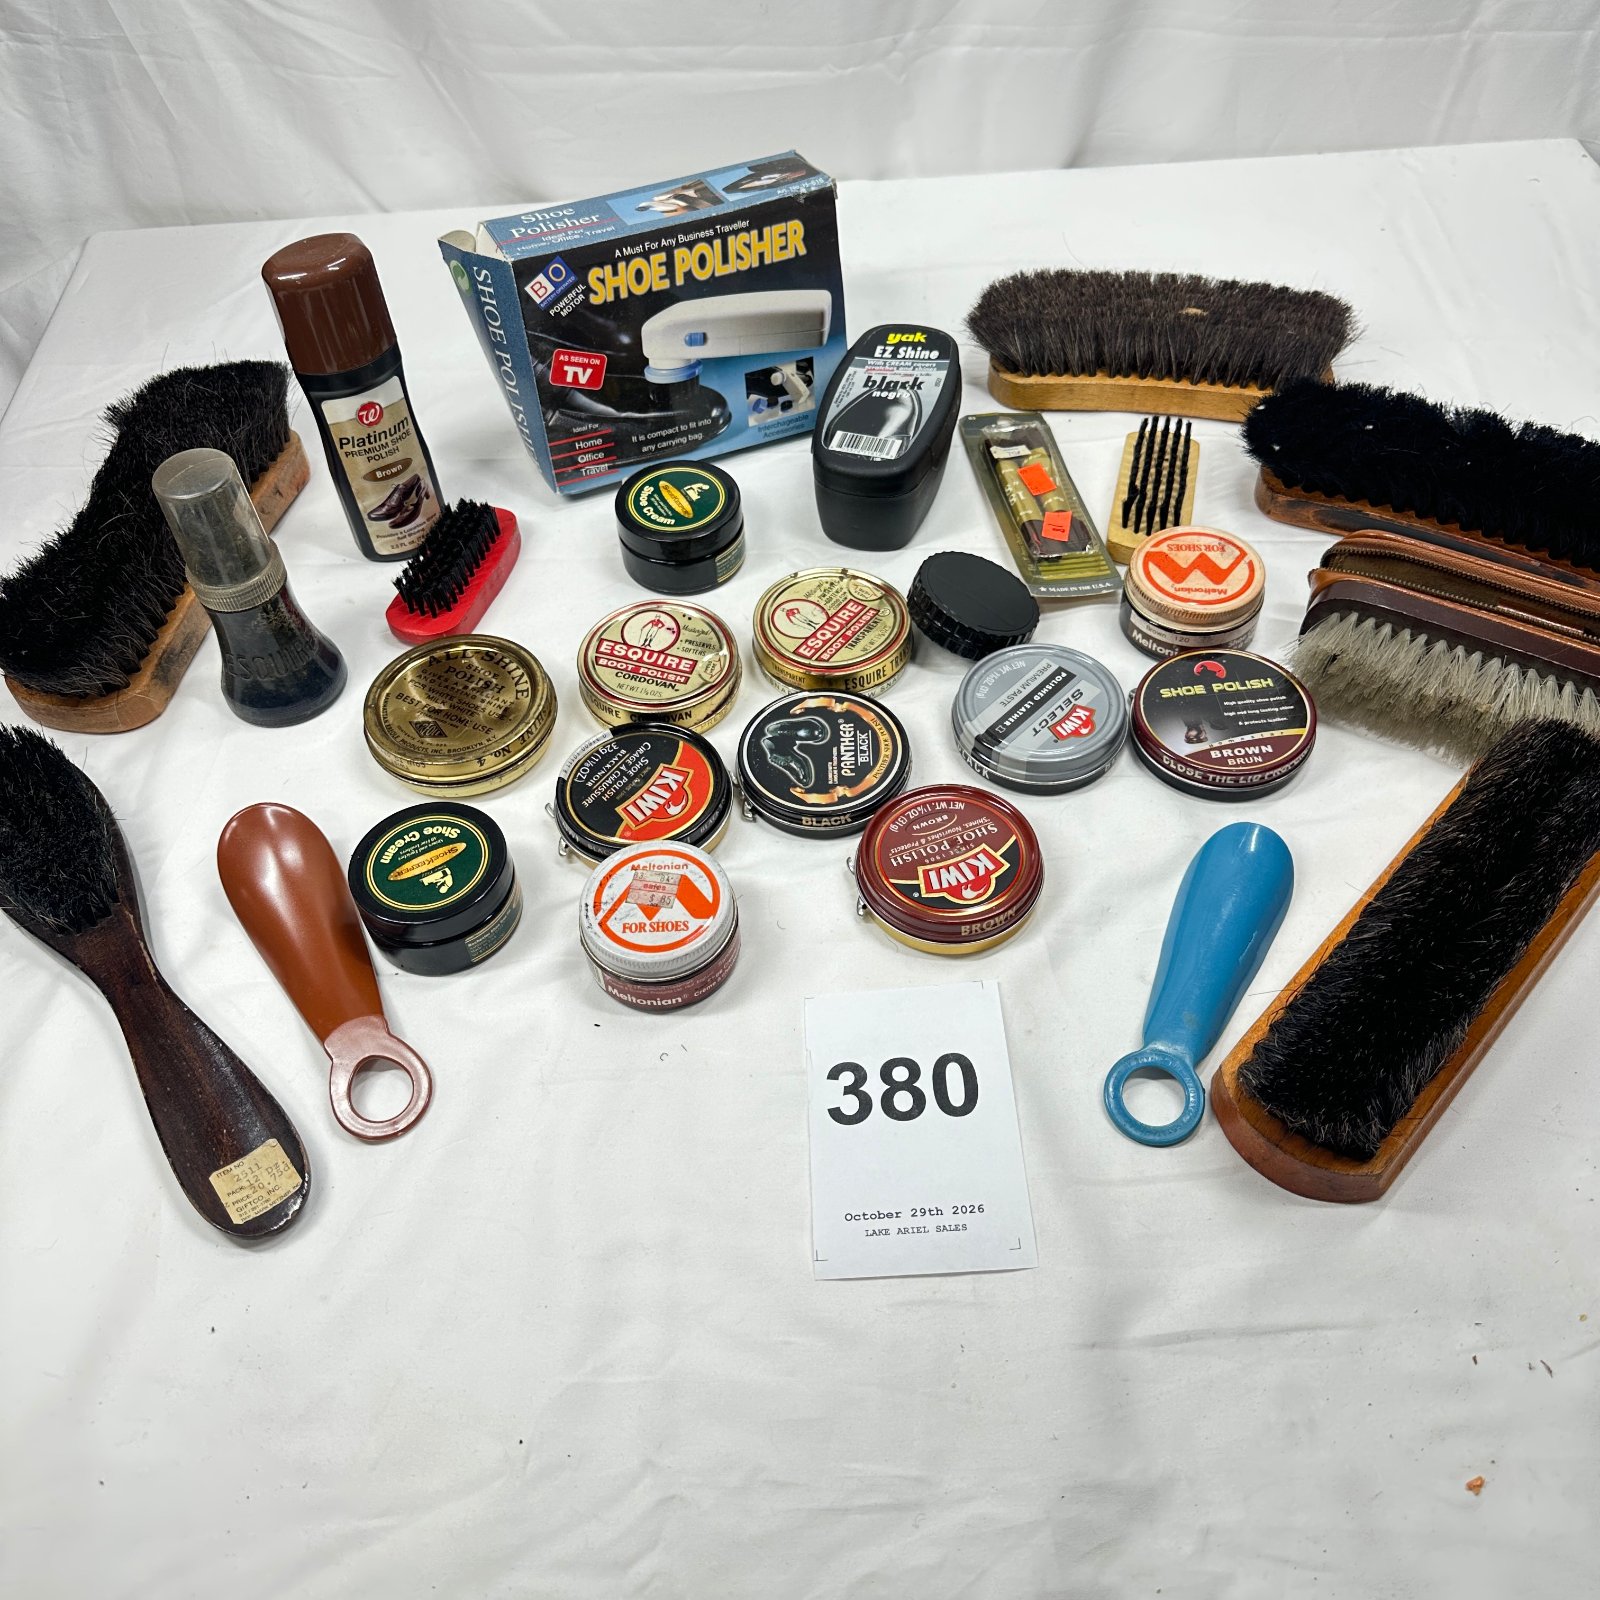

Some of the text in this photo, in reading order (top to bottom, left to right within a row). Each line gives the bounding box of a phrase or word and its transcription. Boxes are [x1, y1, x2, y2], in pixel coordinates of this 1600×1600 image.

[521, 207, 576, 224] Shoe
[509, 214, 600, 239] Polisher
[615, 219, 749, 258] A Must For Any Business Traveller
[587, 220, 807, 306] SHOE POLISHER
[473, 266, 507, 345] SHOE
[549, 283, 586, 317] POWERFUL
[560, 295, 586, 318] MOTOR
[886, 332, 928, 344] yak
[874, 345, 939, 359] EZ Shine
[563, 366, 593, 384] TV
[862, 375, 926, 390] black
[872, 390, 911, 399] negro
[339, 416, 409, 450] Platinum
[573, 425, 587, 433] Ideal
[647, 426, 679, 441] compact
[698, 418, 712, 427] into
[344, 429, 412, 458] PREMIUM SHOE
[575, 437, 603, 450] Home
[642, 443, 656, 452] any
[657, 436, 687, 449] carrying
[367, 447, 400, 463] POLISH
[577, 451, 605, 463] Office
[376, 464, 403, 479] Brown
[580, 464, 609, 477] Travel
[640, 486, 654, 507] Shoe
[642, 507, 675, 525] Cream
[1167, 544, 1227, 552] FOR SHOES
[1174, 587, 1228, 595] Meltonian
[800, 601, 863, 657] ESQUIRE
[820, 638, 845, 660] BOOT
[846, 609, 877, 639] POLISH
[845, 616, 883, 651] TRANSPARENT
[681, 647, 706, 657] SOFTENS
[684, 639, 717, 650] PRESERVES
[599, 640, 694, 672] ESQUIRE
[1013, 660, 1026, 668] NET
[416, 674, 435, 684] AND
[421, 668, 449, 682] GIVES
[444, 665, 506, 694] POLISH
[466, 664, 500, 679] SHOE
[481, 650, 530, 700] SHINE
[598, 658, 686, 683] BOOT POLISH
[772, 662, 806, 684] TRANSPARENT
[845, 666, 887, 691] ESQUIRE
[615, 672, 677, 690] CORDOVAN
[1001, 662, 1052, 707] PREMIUM PASTE
[1159, 678, 1274, 698] SHOE POLISH
[428, 686, 455, 700] WHITE
[456, 698, 486, 713] SHOES
[1003, 671, 1067, 726] POLISHED LEATHER
[395, 692, 422, 707] BEST
[423, 703, 441, 715] FOR
[443, 712, 470, 727] HOME
[472, 722, 494, 735] USE
[1032, 688, 1084, 737] SELECT
[1056, 708, 1090, 736] KIWI
[599, 741, 620, 754] 32g
[626, 741, 652, 766] CIRAGE
[839, 723, 856, 776] PANTHER
[859, 732, 869, 762] BLACK
[1210, 745, 1273, 759] BROWN
[476, 759, 487, 768] 4
[586, 749, 627, 787] BLACK/NOIR
[630, 756, 649, 777] SHOE
[1162, 755, 1203, 779] CLOSE
[1207, 774, 1234, 783] THE
[1227, 755, 1263, 765] BRUN
[581, 771, 621, 808] CHAUSSURE
[602, 776, 628, 802] POLISH
[626, 770, 684, 822] KIWI
[948, 802, 965, 810] NET
[802, 814, 852, 826] BLACK
[912, 814, 949, 831] BROWN
[423, 826, 461, 839] Shoe
[927, 826, 962, 841] Nourishes
[380, 832, 421, 864] Cream
[890, 823, 998, 867] SHOE POLISH
[630, 863, 689, 871] Meltonian
[924, 853, 946, 864] 1906
[928, 853, 996, 890] KIWI
[622, 921, 689, 933] FOR SHOES
[960, 907, 1017, 936] BROWN
[608, 986, 682, 1006] Meltonian
[826, 1052, 979, 1126] 380
[217, 1161, 245, 1178] ITEM NO
[234, 1162, 262, 1182] 2511
[248, 1175, 260, 1186] 12
[236, 1195, 264, 1213] GIFTCO
[845, 1204, 985, 1222] October 29th 2026
[865, 1224, 968, 1237] LAKE ARIEL SALES
